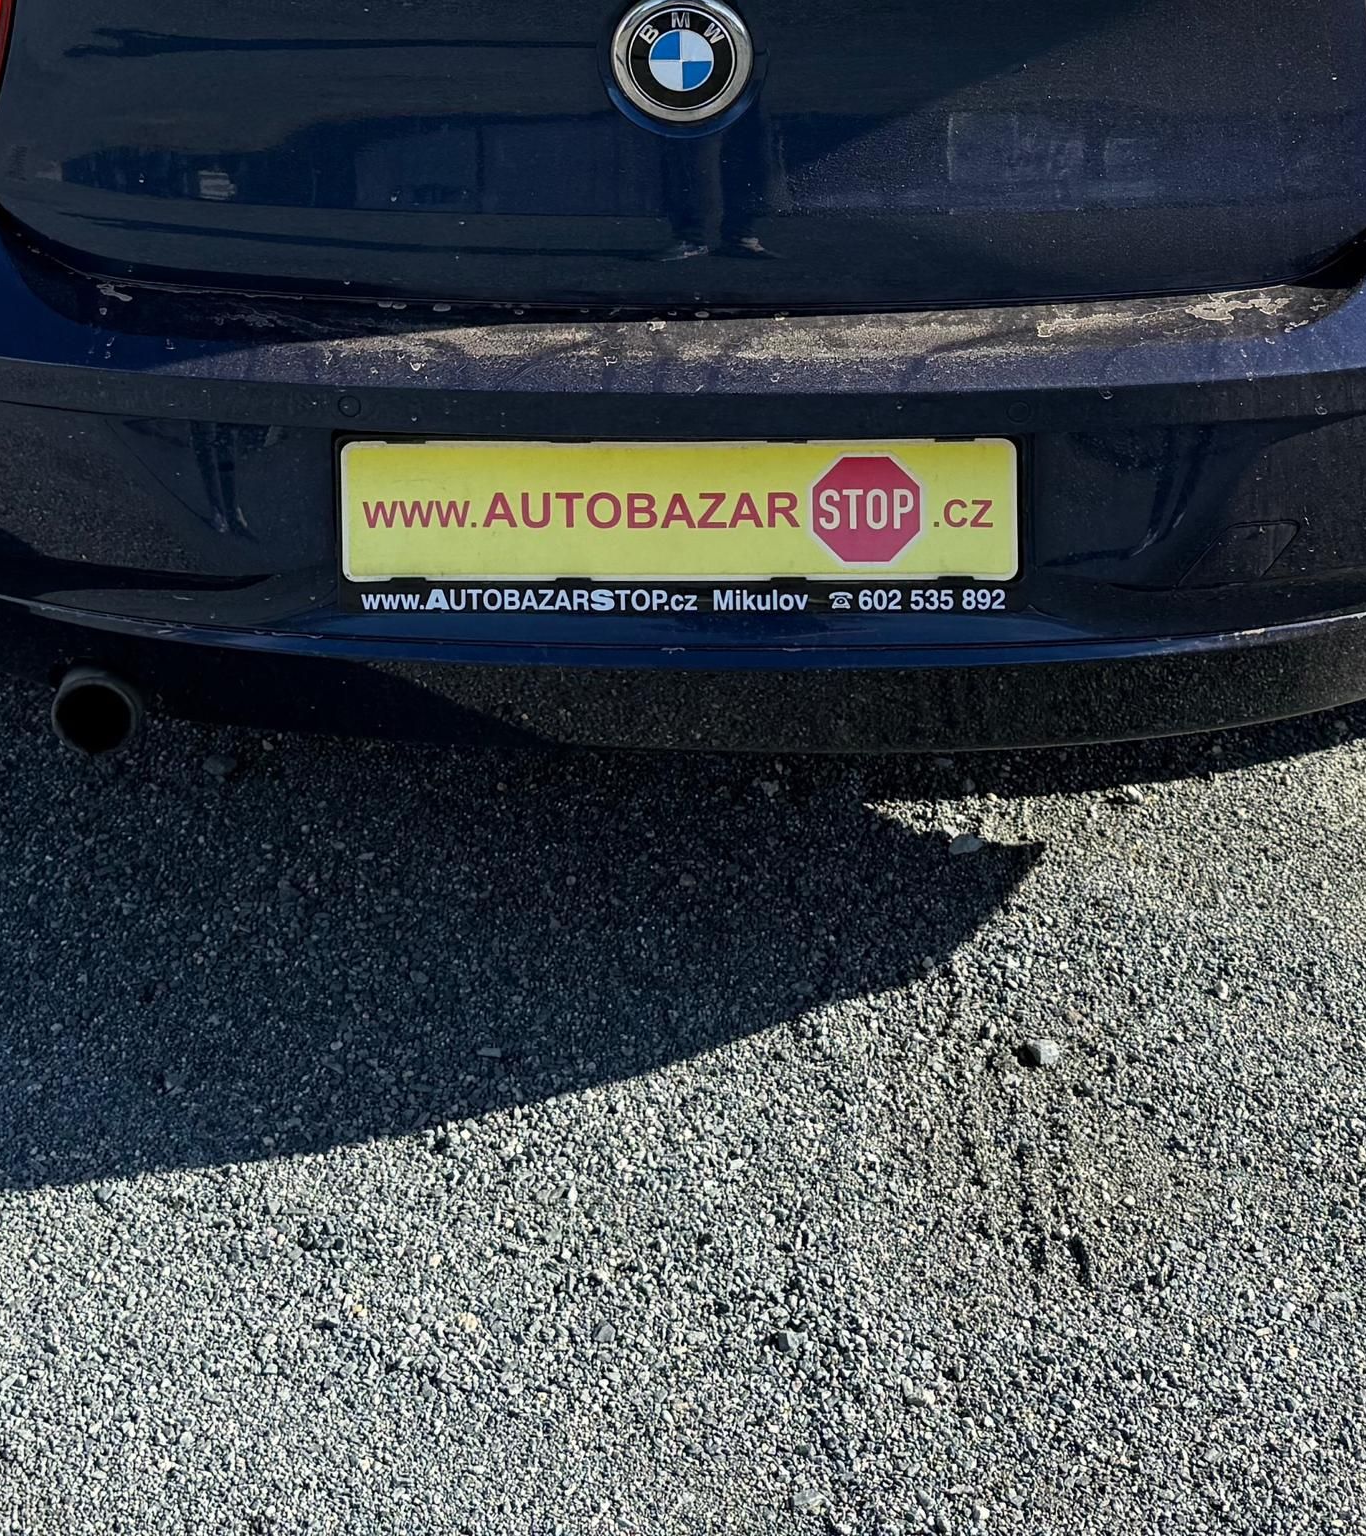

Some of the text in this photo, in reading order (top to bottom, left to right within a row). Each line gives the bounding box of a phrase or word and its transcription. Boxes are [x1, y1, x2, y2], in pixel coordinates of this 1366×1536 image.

[638, 11, 726, 45] BMW
[818, 487, 915, 531] STOP
[712, 588, 810, 612] Mikulov
[857, 588, 903, 611] 602
[909, 588, 955, 611] 535
[961, 588, 1007, 611] 892
